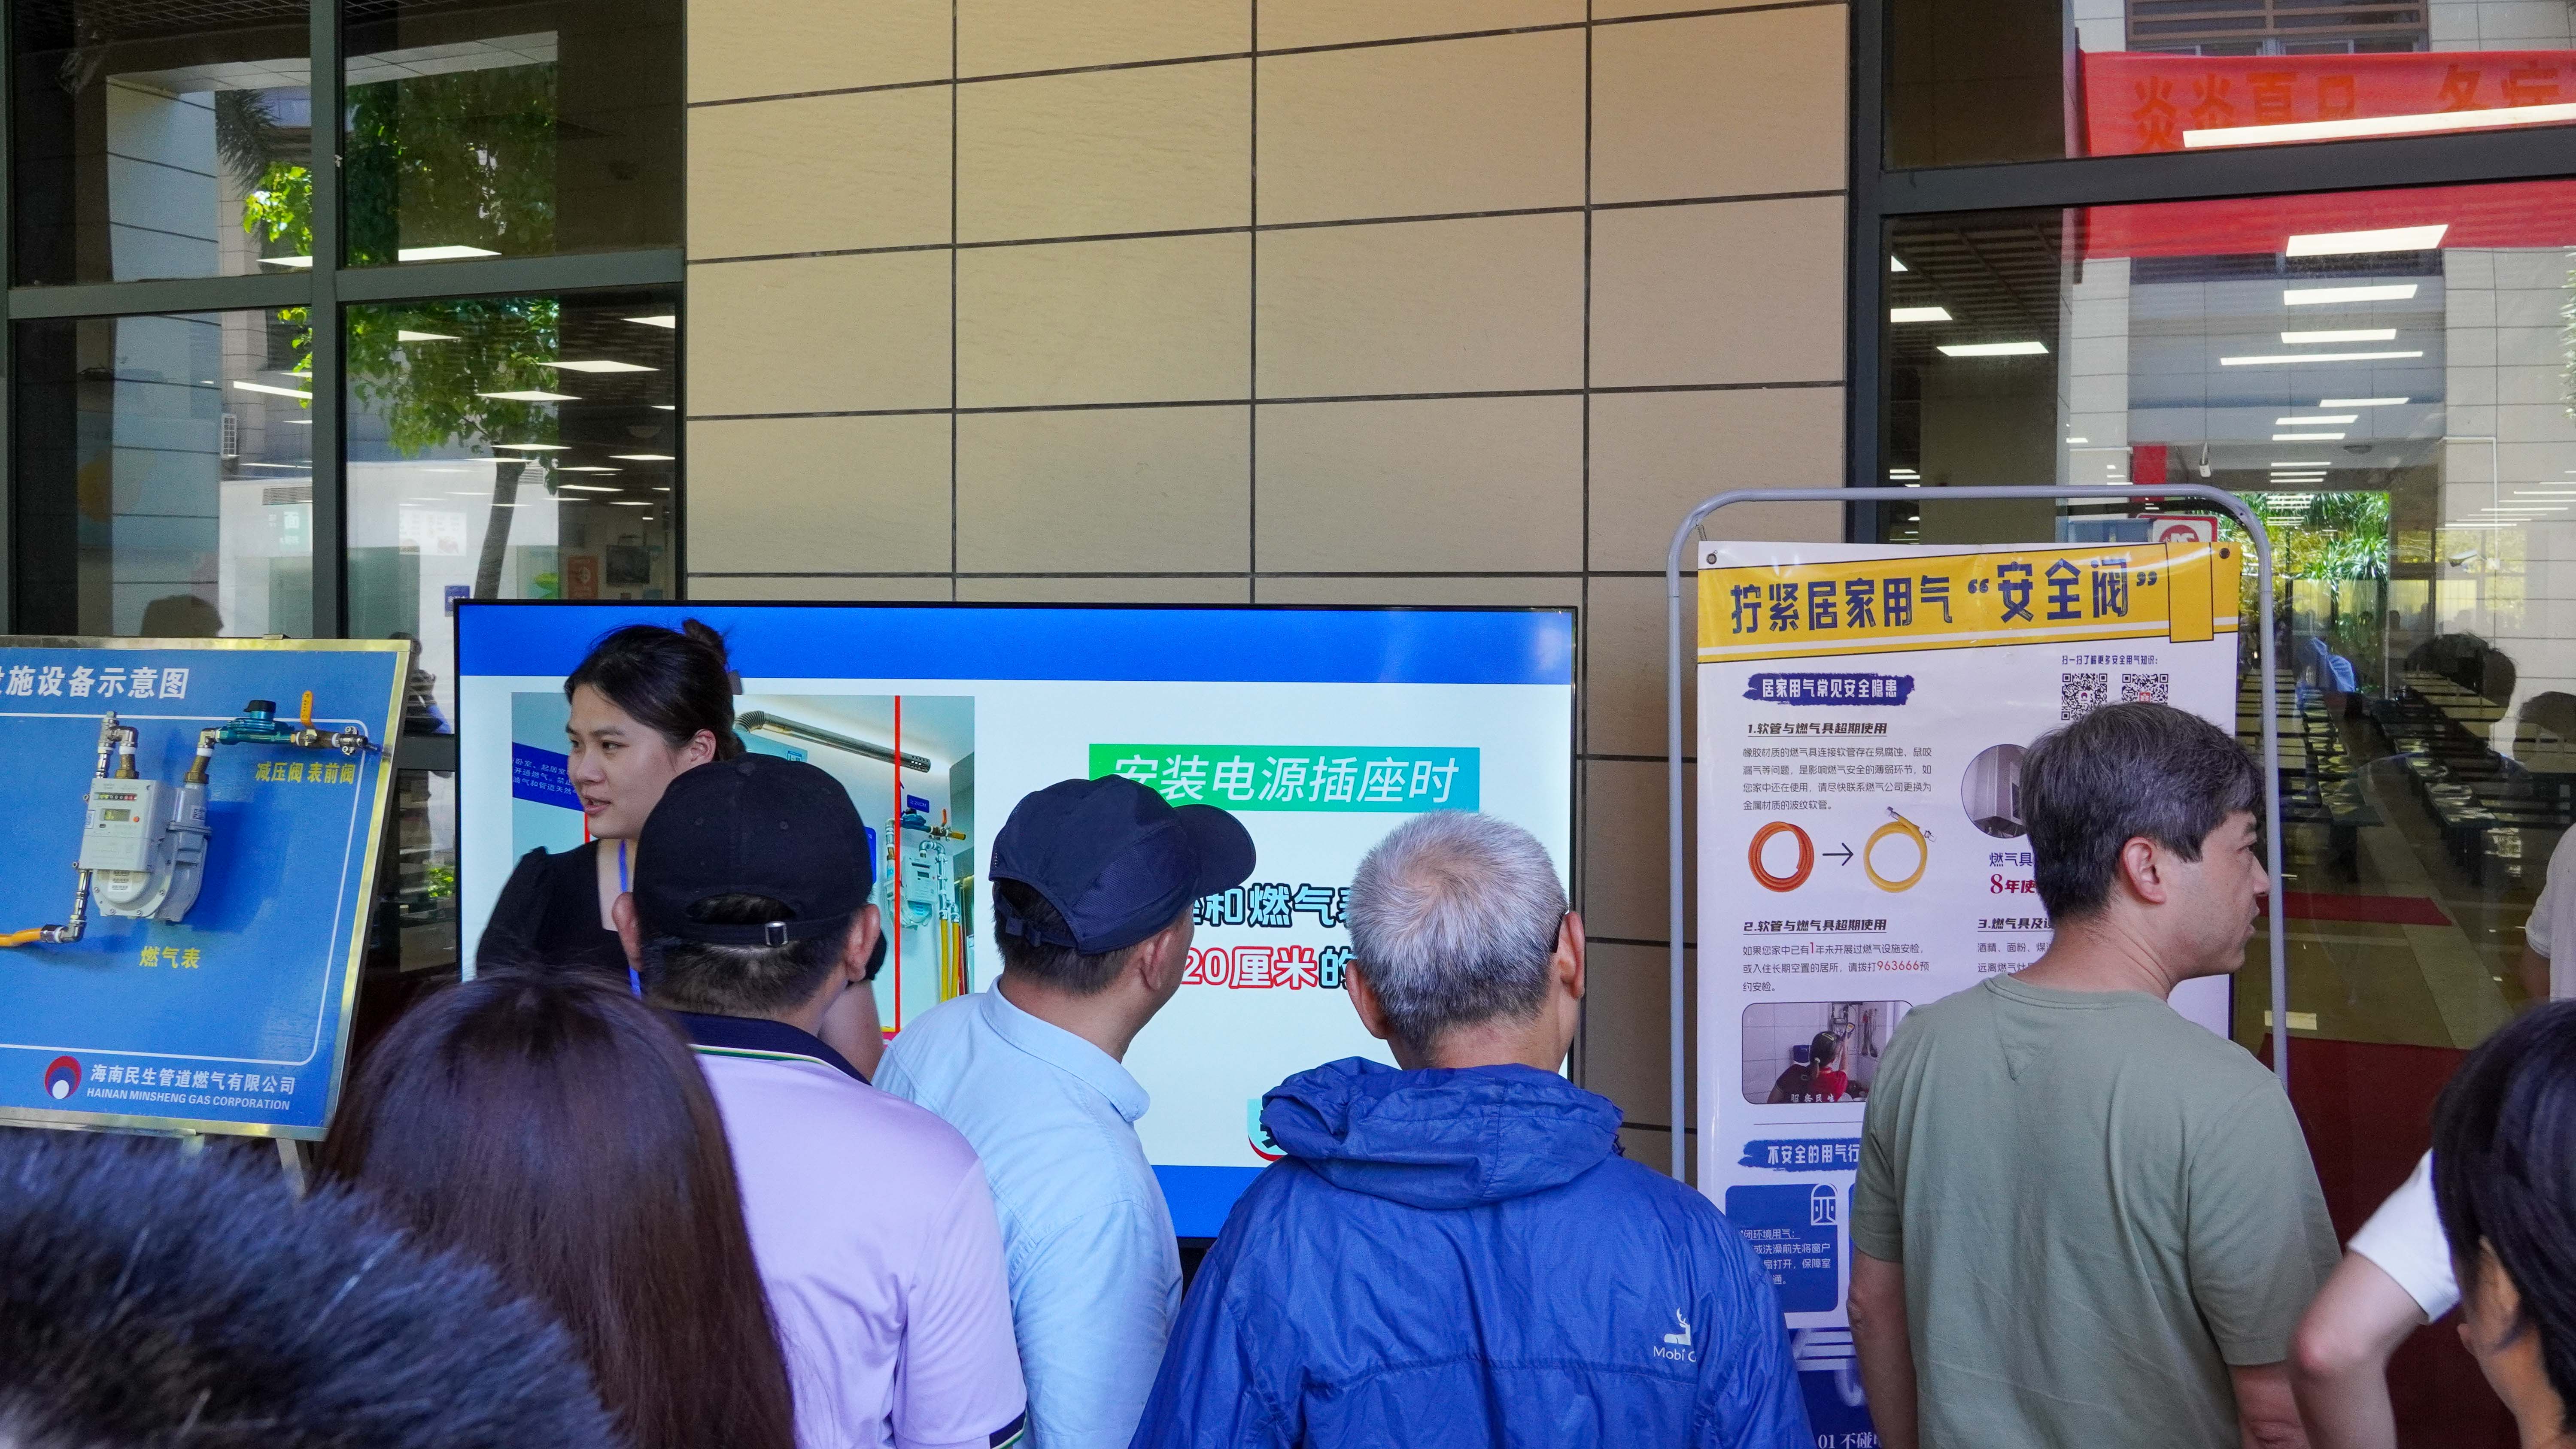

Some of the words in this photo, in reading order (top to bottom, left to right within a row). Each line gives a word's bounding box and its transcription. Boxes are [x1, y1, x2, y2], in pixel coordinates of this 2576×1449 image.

[1730, 558, 2159, 634] 拧紧居家用气“安全阀”
[0, 665, 190, 699] 施设备示意图
[1762, 678, 1897, 698] 居家用气常见安全隐患
[1747, 722, 1887, 735] 1.软管与燃气具超期使用
[1115, 754, 1460, 805] 安装电源插座时
[1743, 782, 1932, 793] 您家中还在使用，请尽快联系燃气公司更换为
[1743, 800, 1833, 811] 金属材质的波纹软管。
[1989, 852, 2033, 867] 燃气具
[1192, 882, 1352, 928] 和燃气
[1744, 919, 1887, 932] 2.软管与燃气具超期使用
[139, 946, 202, 969] 燃气表
[1743, 960, 1930, 973] 或入住长期空置的居所，请拨打963666预
[1978, 962, 2034, 973] 远离燃气灶
[1743, 982, 1776, 992] 约安检。
[90, 1064, 295, 1095] 海南民生管道燃气有限公司
[87, 1088, 128, 1100] HAINAN
[129, 1091, 186, 1103] MINSHENG
[188, 1094, 210, 1105] GAS
[213, 1096, 290, 1110] CORPORATION
[1741, 1229, 1795, 1240] 闭环境用气：
[1653, 1346, 1686, 1361] Mobi
[1818, 1434, 1835, 1449] 01
